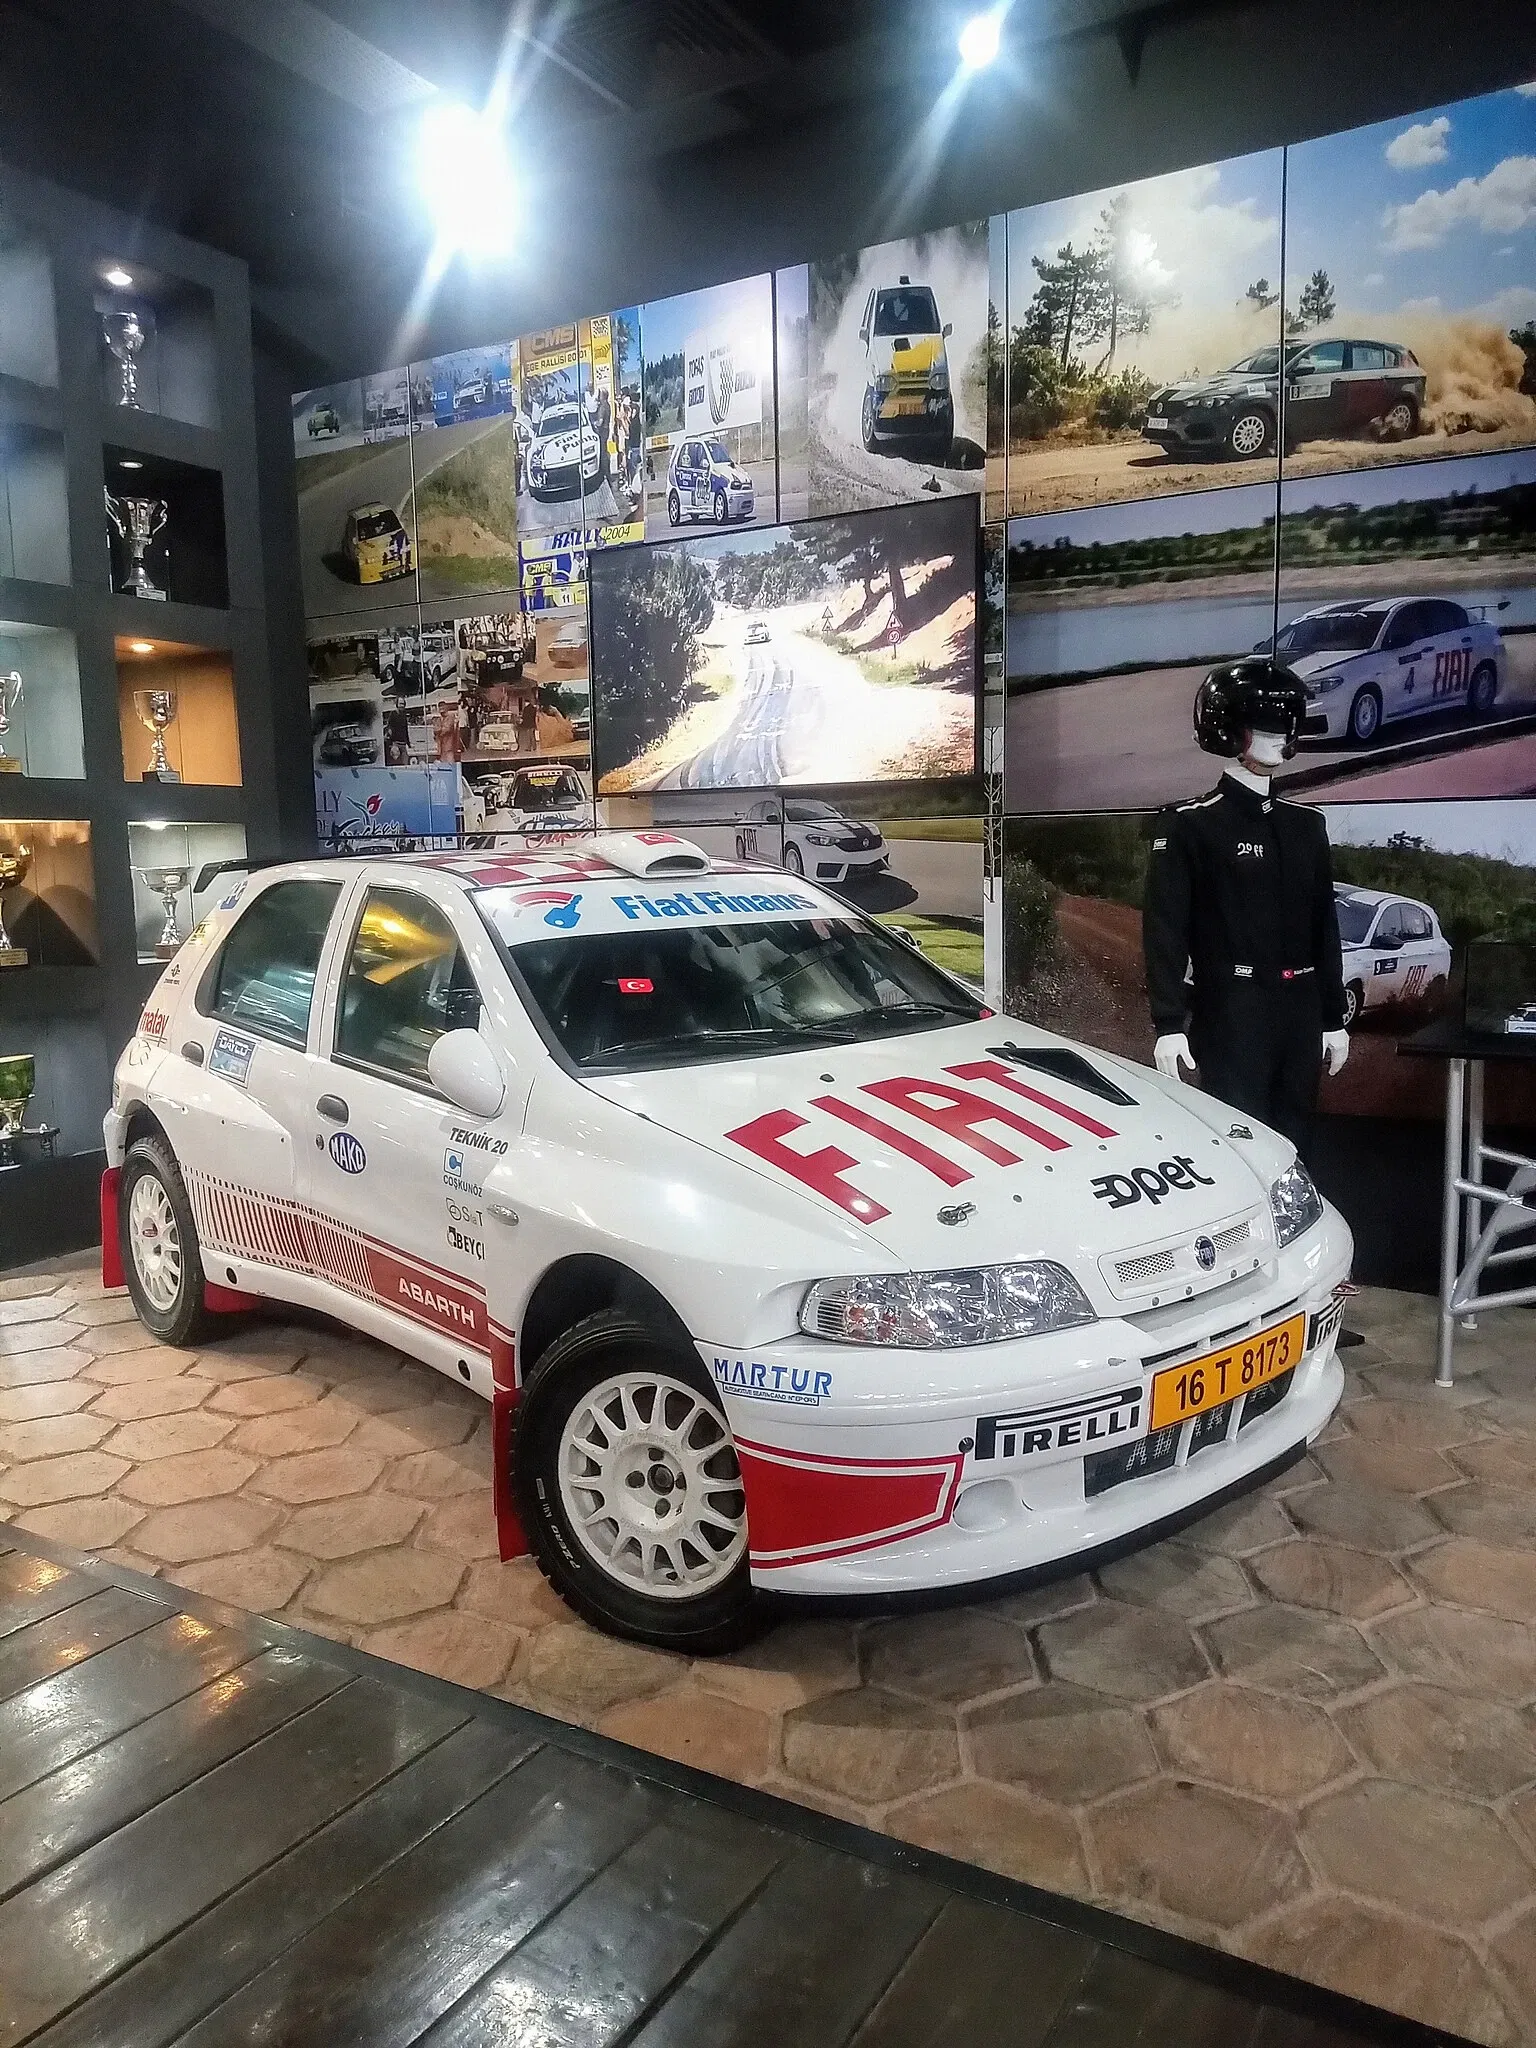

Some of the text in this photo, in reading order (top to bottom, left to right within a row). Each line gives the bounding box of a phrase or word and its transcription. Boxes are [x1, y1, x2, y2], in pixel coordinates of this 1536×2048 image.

[1403, 667, 1415, 694] 4
[1432, 648, 1473, 698] FIAT
[610, 889, 819, 921] Fiat Finans
[449, 1127, 509, 1155] TEKNİK 20
[723, 1060, 1121, 1226] FIAT
[443, 1174, 483, 1198] COŞKUNÖZ
[398, 1276, 476, 1330] ABARTH
[714, 1357, 833, 1395] MARTUR
[1175, 1331, 1290, 1411] 16 T 8173
[975, 1384, 1144, 1461] PIRELLI
